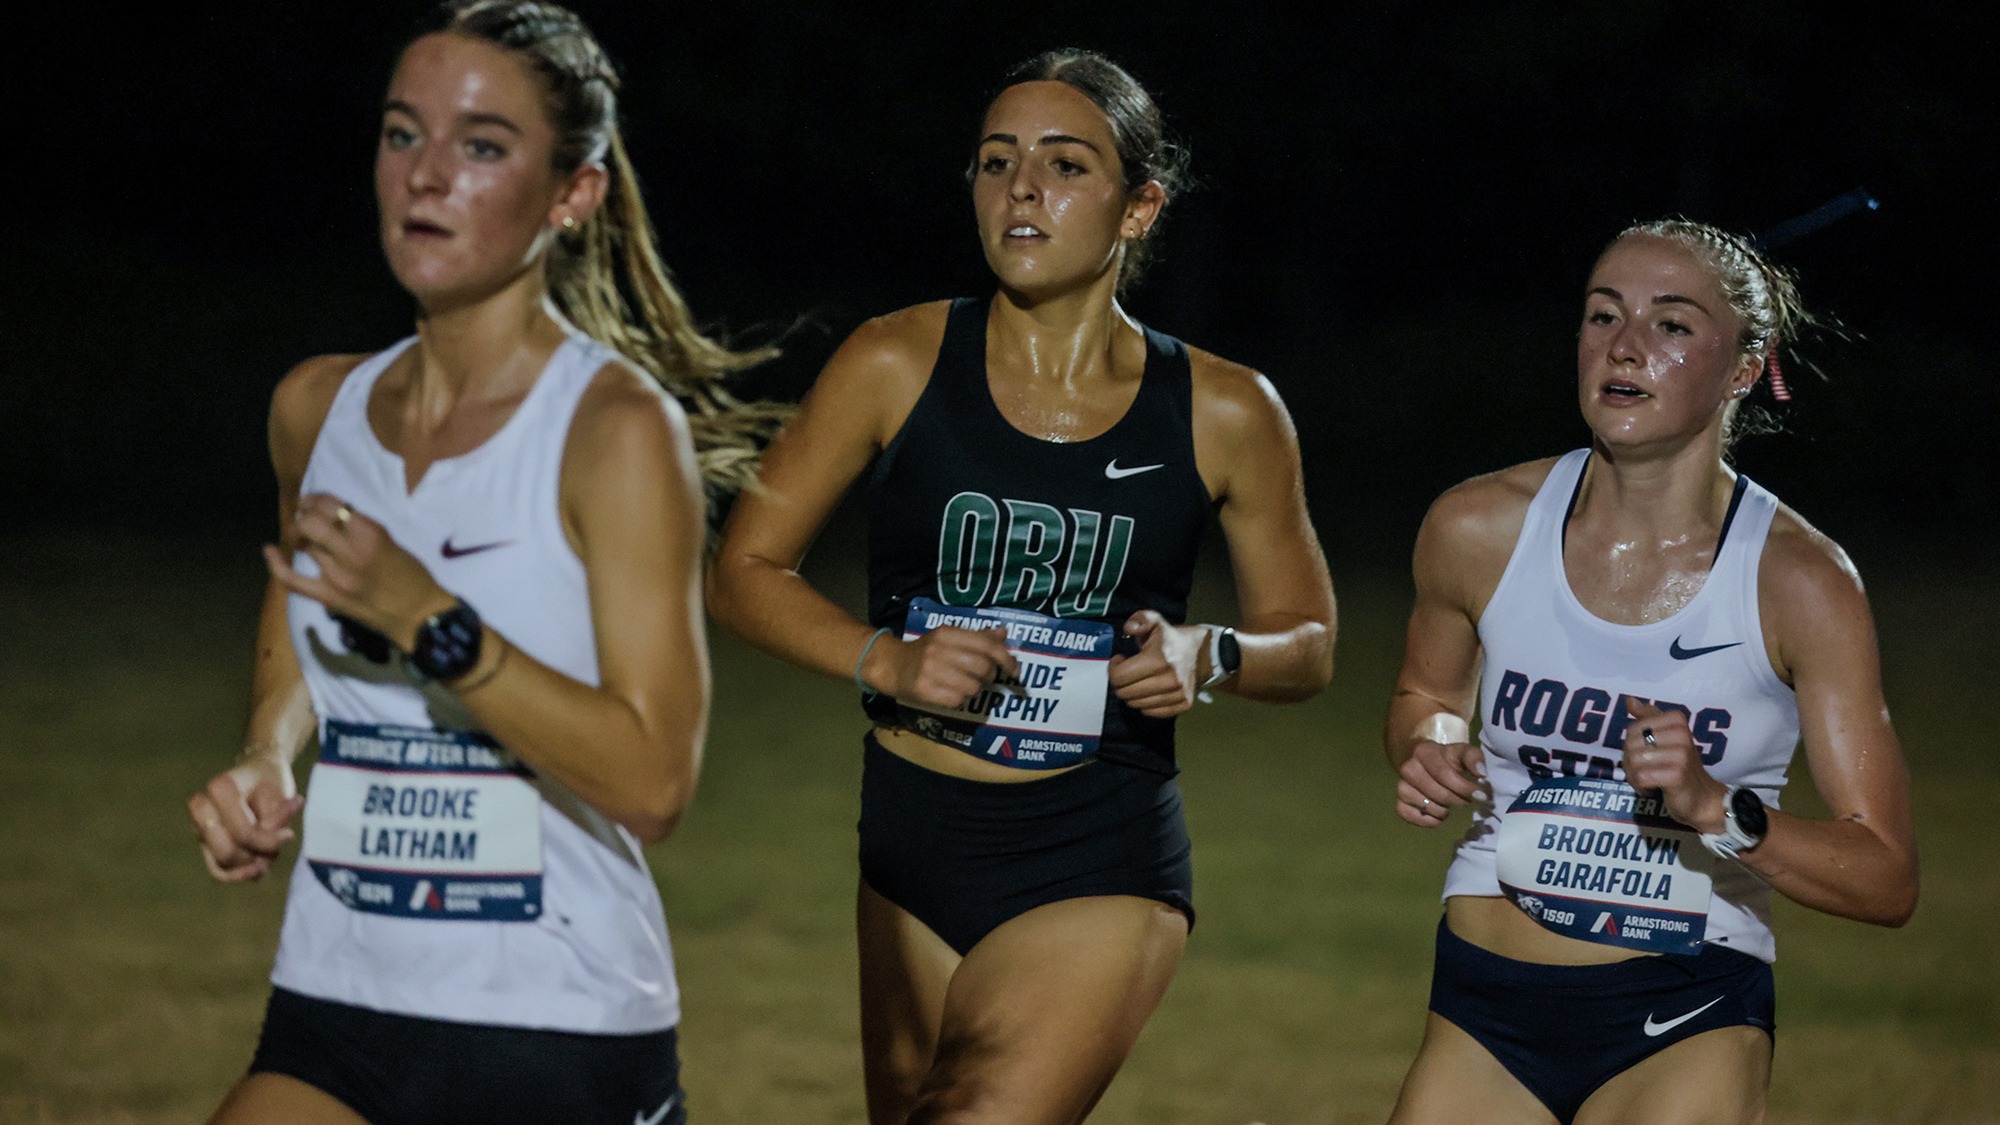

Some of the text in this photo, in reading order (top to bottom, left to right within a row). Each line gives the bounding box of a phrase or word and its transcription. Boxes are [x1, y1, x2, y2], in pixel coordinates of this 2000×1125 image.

[937, 491, 1135, 617] OBU
[1005, 623, 1053, 646] AFTER
[1053, 629, 1099, 653] DARK
[960, 689, 1060, 724] URPHY
[1017, 750, 1046, 762] BANK
[1018, 738, 1084, 754] ARMSTRONG
[362, 784, 479, 819] BROOKE
[1525, 788, 1605, 810] DISTANCE
[1605, 794, 1658, 816] AFTER
[360, 827, 478, 861] LATHAM
[1537, 823, 1681, 866] BROOKLYN
[1535, 859, 1673, 901] GARAFOLA
[1542, 907, 1575, 927] 1590
[1623, 914, 1690, 934] ARMSTRONG
[1622, 926, 1651, 941] BANK
